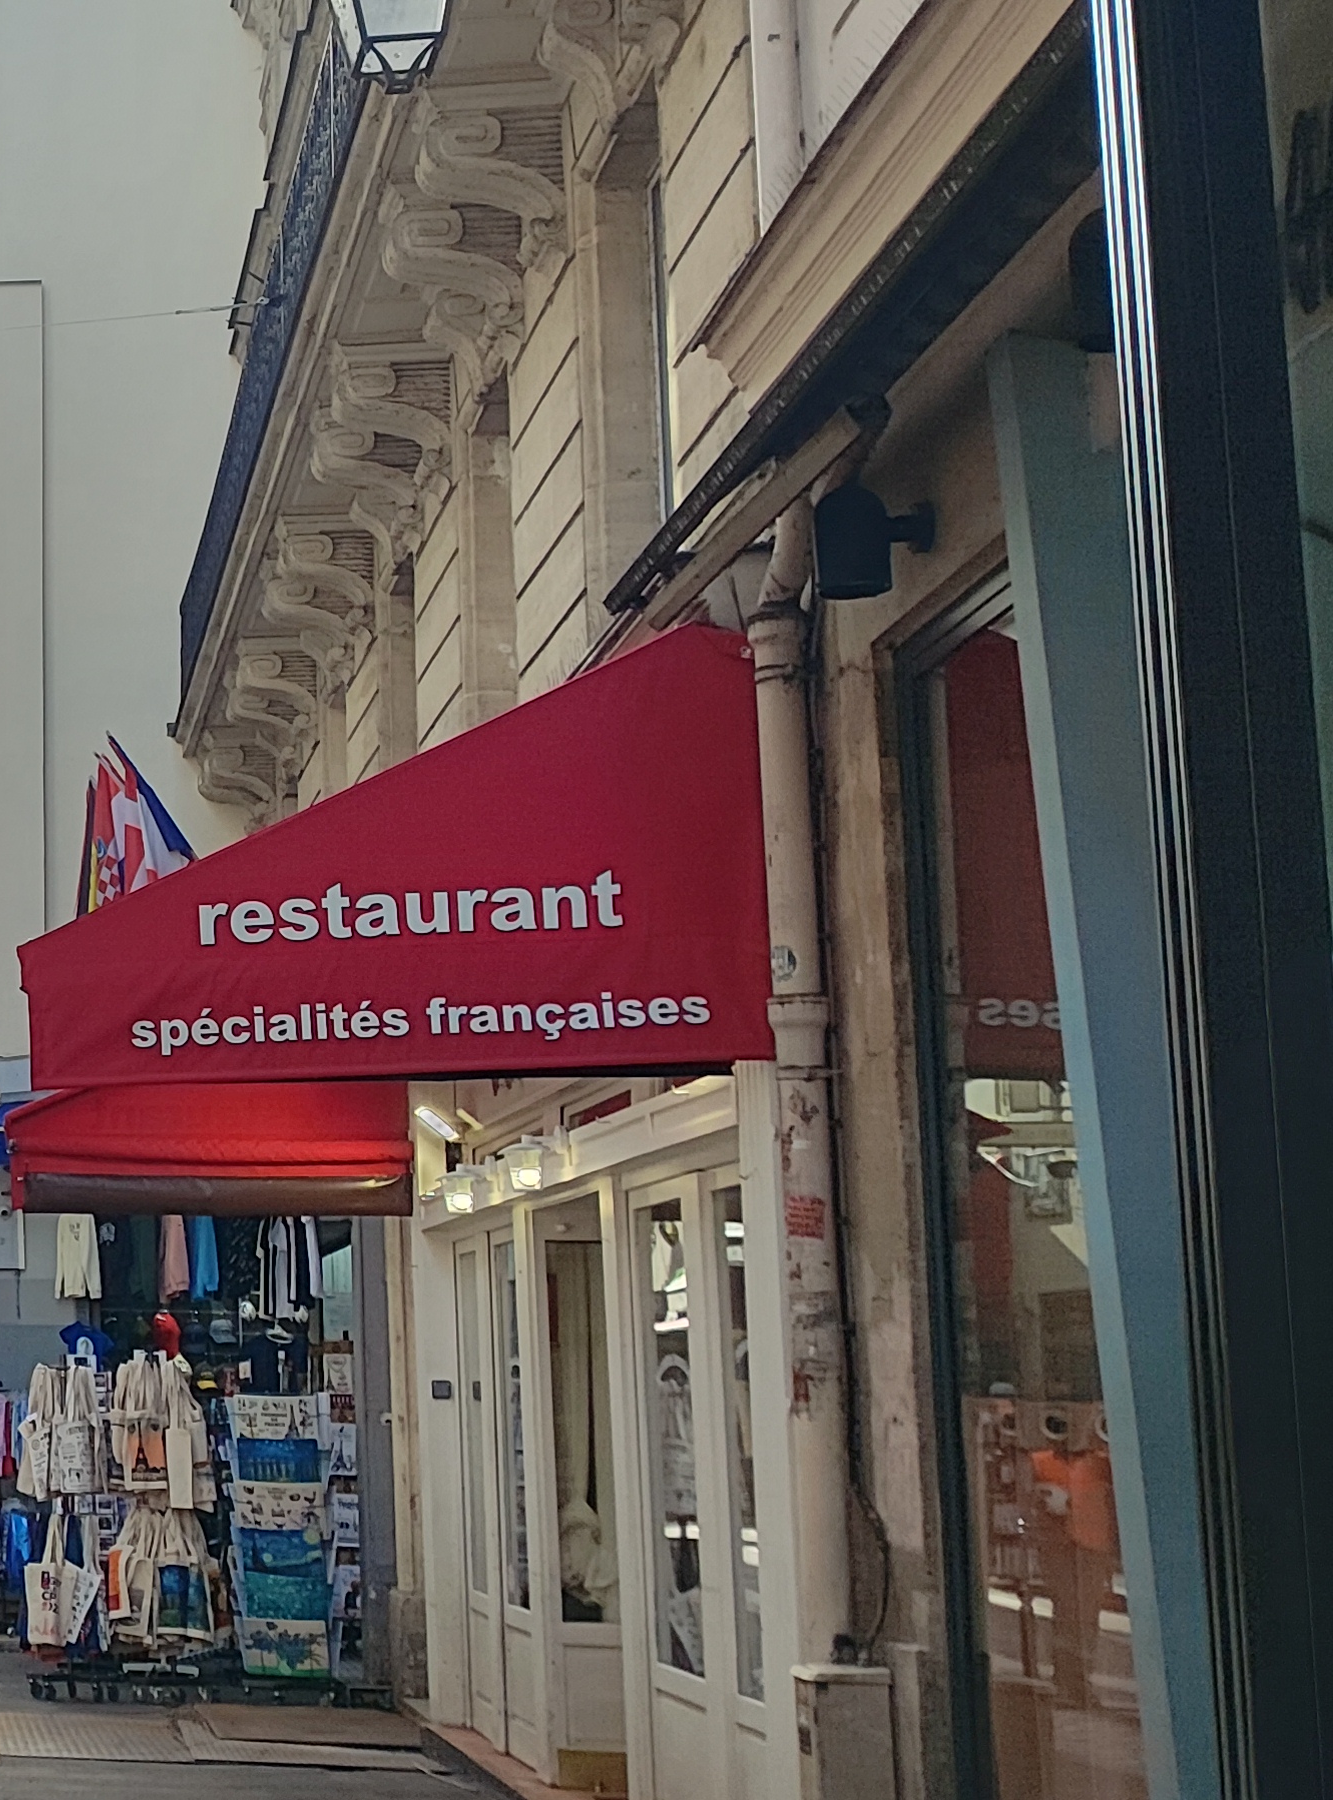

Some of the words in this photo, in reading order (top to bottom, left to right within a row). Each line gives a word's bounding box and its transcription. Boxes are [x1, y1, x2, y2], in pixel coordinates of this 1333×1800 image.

[198, 869, 624, 945] restaurant
[131, 1002, 411, 1056] spécialités
[426, 991, 711, 1041] françaises
